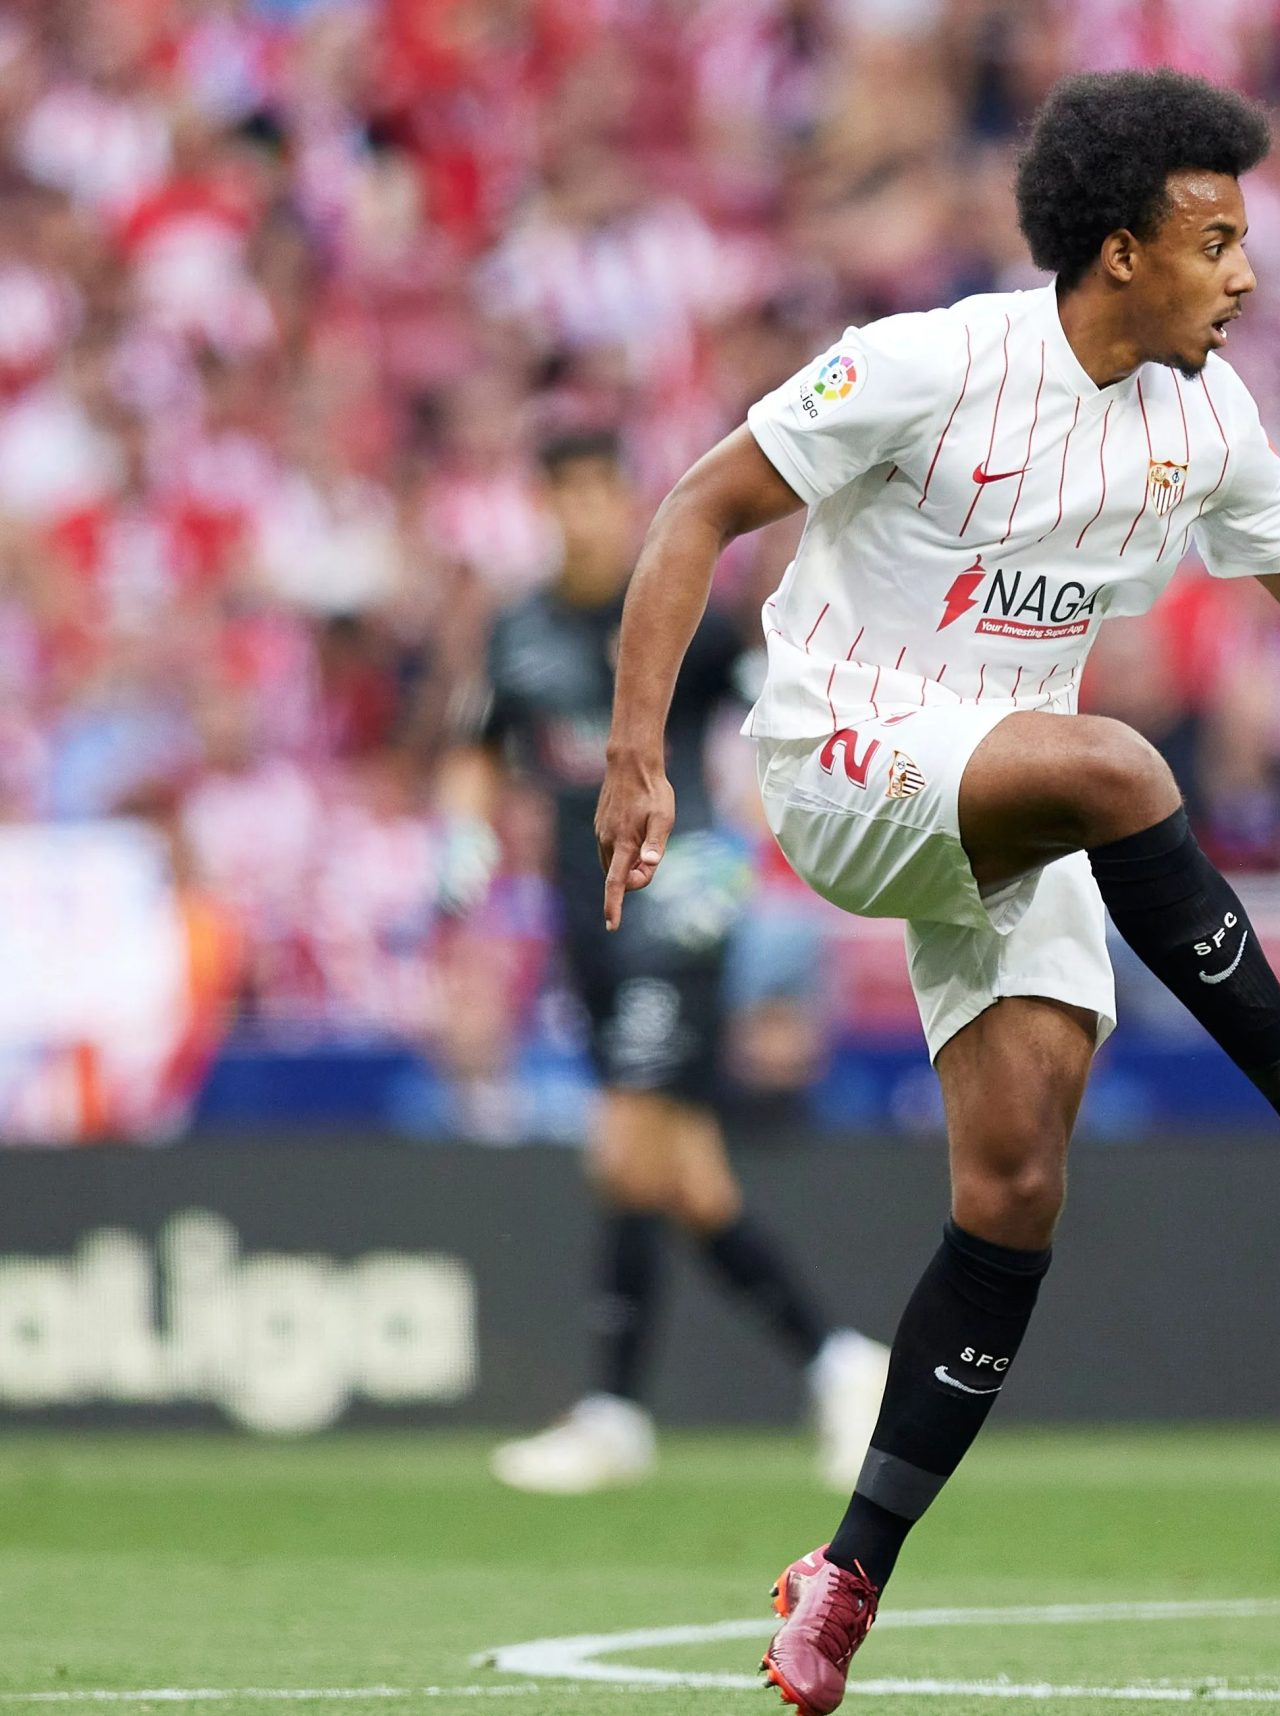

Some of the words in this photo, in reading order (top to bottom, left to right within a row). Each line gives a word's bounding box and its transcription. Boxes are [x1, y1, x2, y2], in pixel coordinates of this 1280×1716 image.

[982, 568, 1106, 623] NAGA
[981, 621, 1003, 632] Your
[1002, 624, 1044, 638] Investing
[1043, 628, 1069, 638] Super
[1066, 623, 1085, 635] App
[1193, 911, 1238, 956] SFC
[960, 1346, 1009, 1372] SFC
